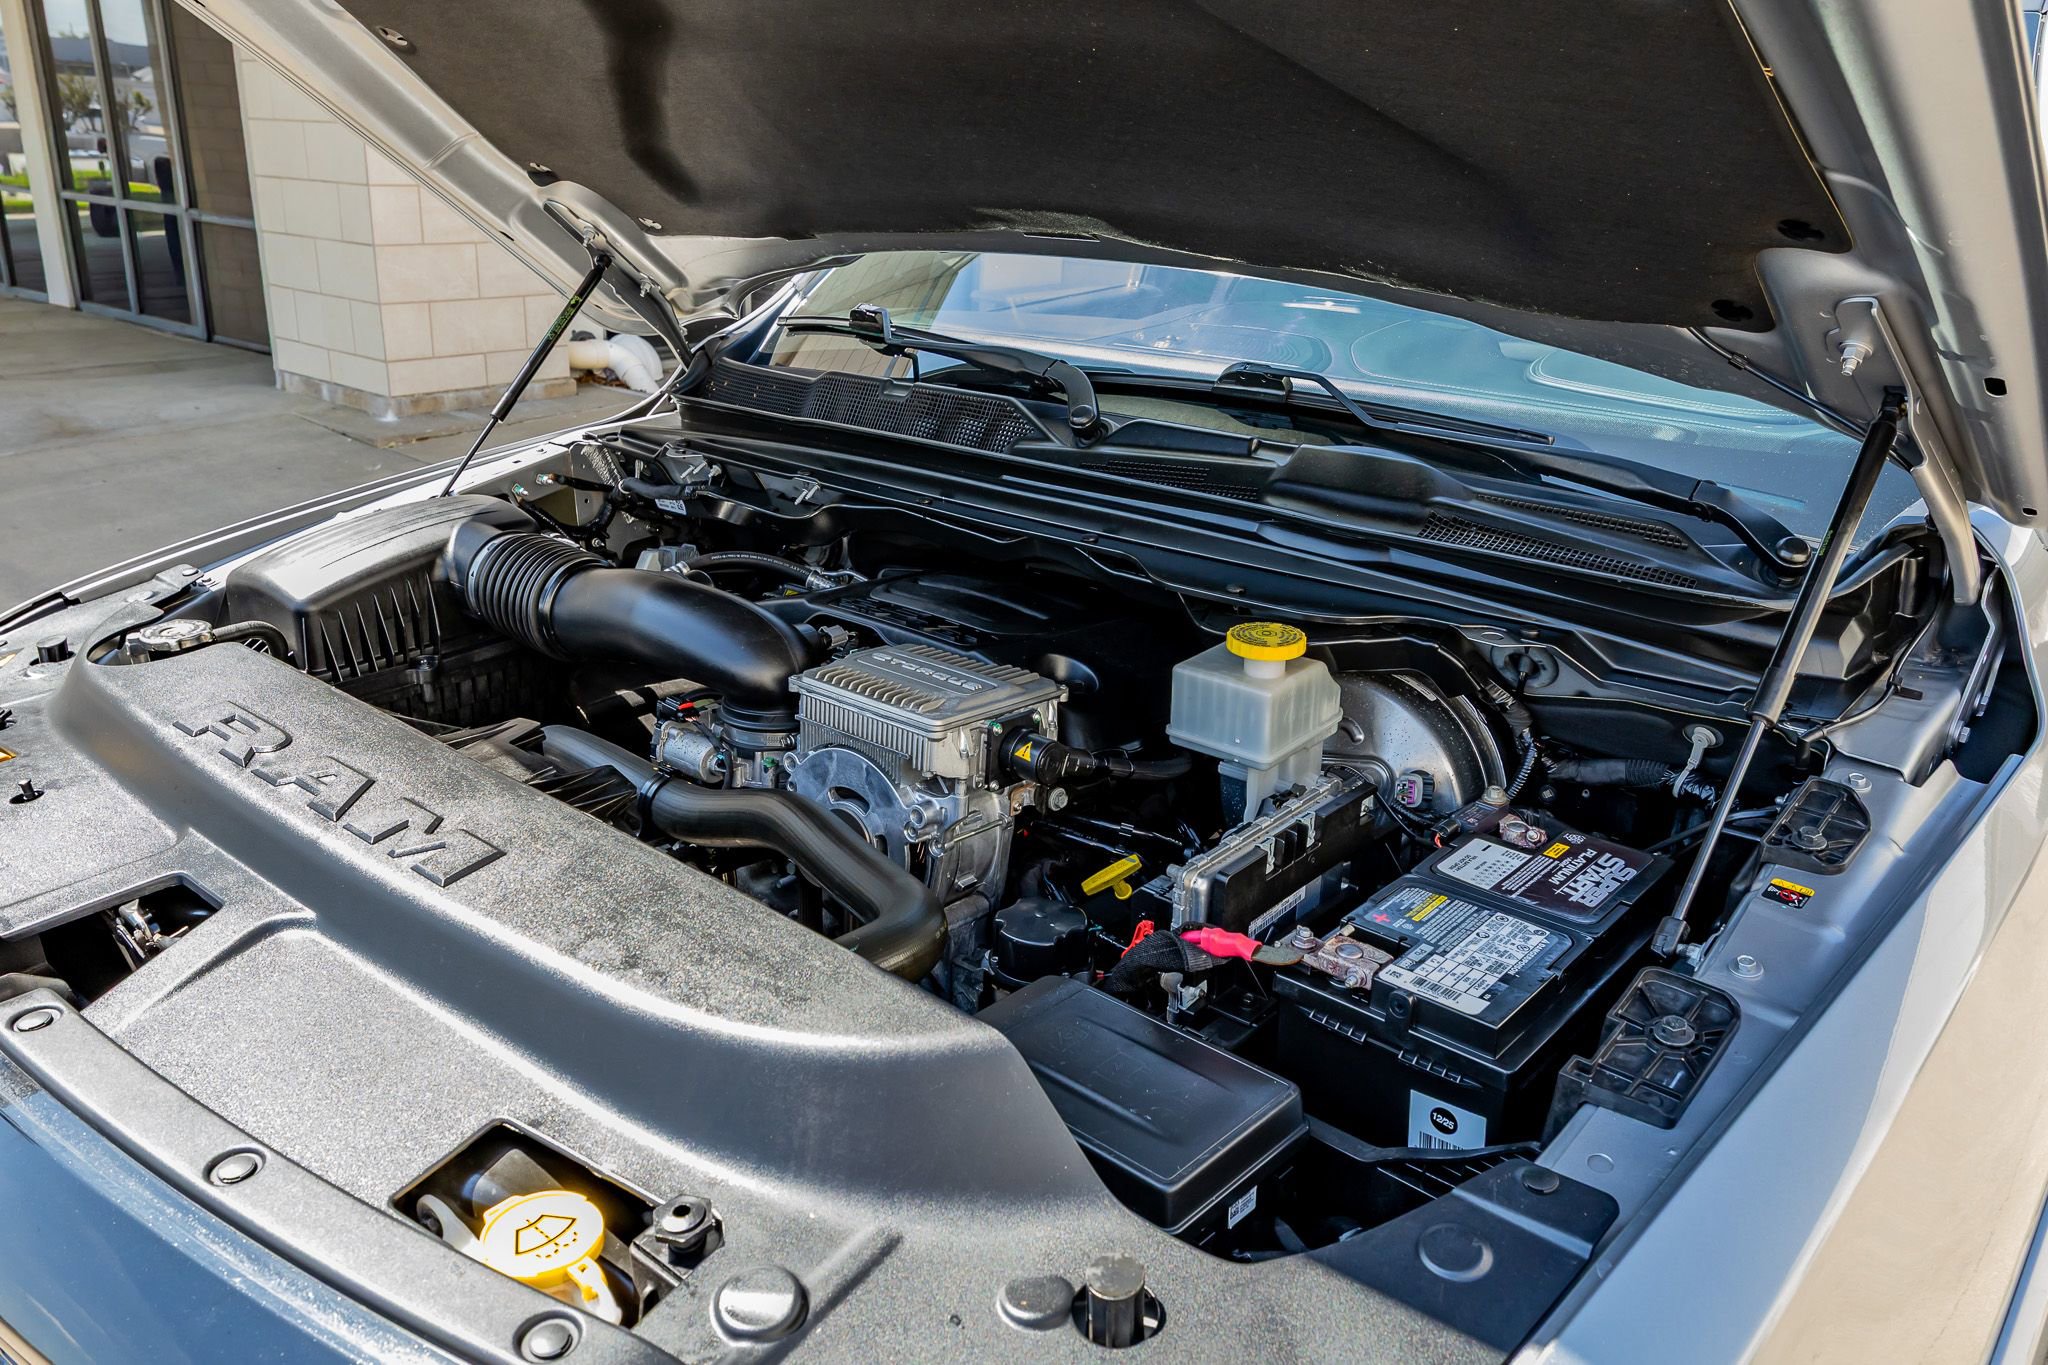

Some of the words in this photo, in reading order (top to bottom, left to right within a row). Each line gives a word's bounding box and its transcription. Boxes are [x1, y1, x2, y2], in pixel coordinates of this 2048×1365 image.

[172, 700, 506, 888] RAM
[1548, 848, 1597, 885] PLATINUM
[1558, 852, 1624, 902] START
[1576, 863, 1638, 908] SUPER
[1432, 1112, 1455, 1130] 12/25
